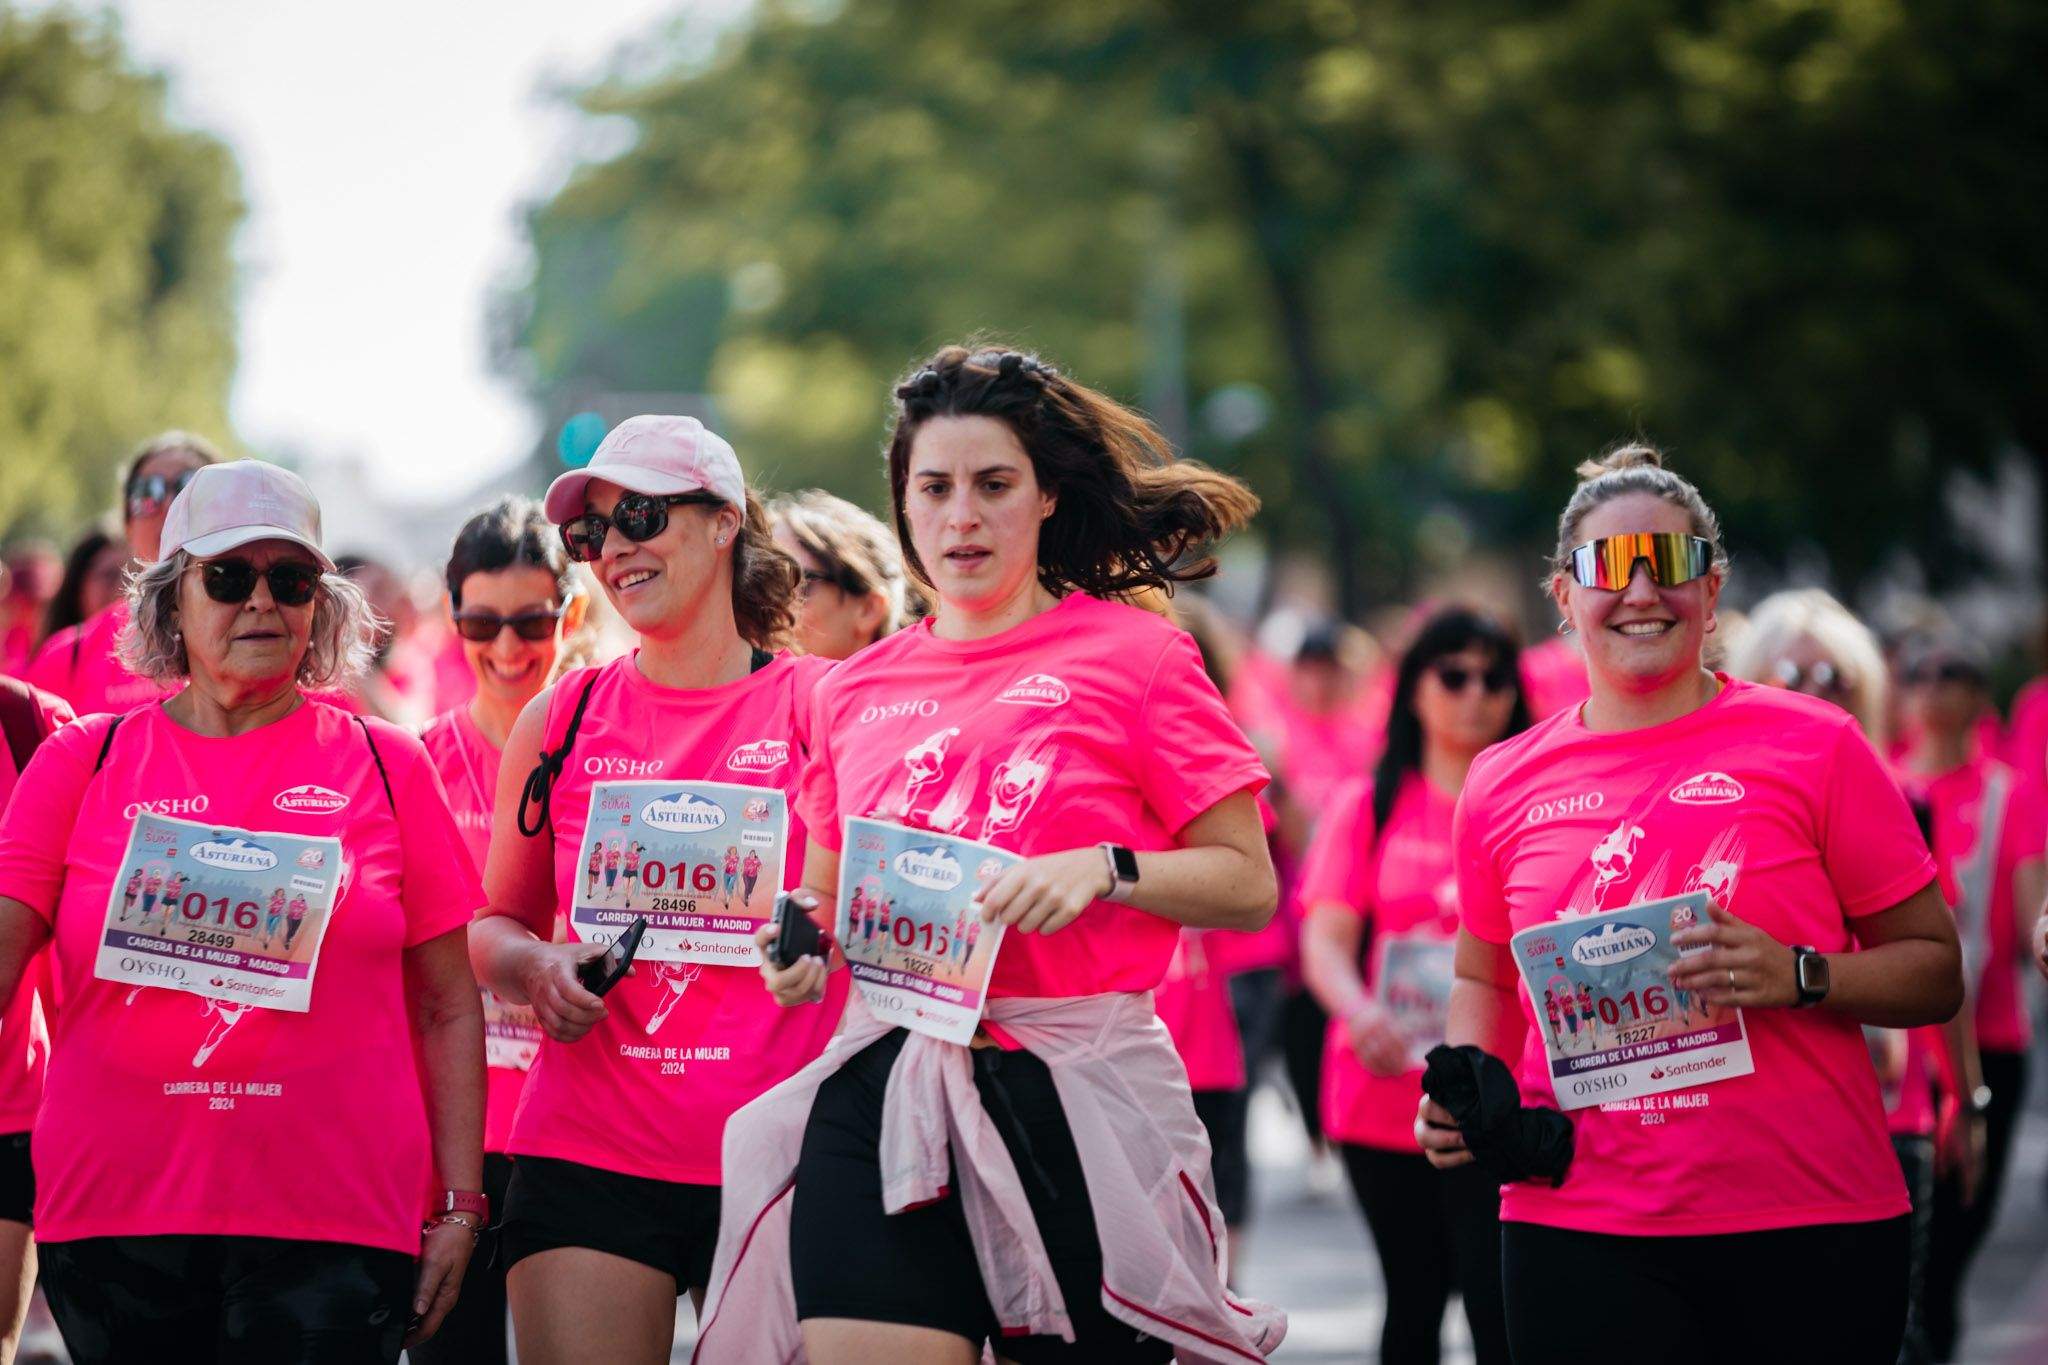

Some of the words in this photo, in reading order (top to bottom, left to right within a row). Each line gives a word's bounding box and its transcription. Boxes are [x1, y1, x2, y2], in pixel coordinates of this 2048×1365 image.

[860, 699, 939, 724] OYSHO
[583, 756, 664, 776] OYSHO
[280, 796, 344, 808] ASTURIANA
[1676, 787, 1739, 800] ASTURIANA
[123, 795, 209, 820] OYSHO
[601, 800, 631, 810] SUMA
[645, 805, 720, 825] ASTURIANA
[1527, 791, 1604, 825] OYSHO
[144, 832, 177, 844] SUMA
[194, 845, 271, 868] ASTURIANA
[642, 860, 717, 892] 016
[181, 892, 261, 930] 016
[651, 897, 696, 912] 28496
[1674, 906, 1693, 923] 20
[596, 911, 639, 923] CARRERA
[656, 915, 669, 926] LA
[671, 916, 704, 928] MUJER
[713, 918, 752, 931] MADRID
[187, 929, 235, 949] 28499
[693, 941, 753, 956] Santander
[1579, 935, 1652, 961] ASTURIANA
[126, 935, 172, 953] CARRERA
[175, 944, 189, 957] DE
[190, 947, 204, 959] LA
[206, 949, 241, 966] MUJER
[248, 958, 291, 974] MADRID
[1527, 942, 1557, 958] SUMA
[120, 957, 186, 981] OYSHO
[225, 978, 287, 998] Santander
[1599, 985, 1670, 1026] 016
[1615, 1026, 1656, 1046] 18227
[620, 1044, 661, 1059] CARRERA
[664, 1048, 678, 1060] DE
[680, 1047, 693, 1060] LA
[695, 1047, 730, 1060] MUJER
[1570, 1056, 1607, 1071] CARRERA
[1608, 1053, 1621, 1063] DE
[1622, 1050, 1635, 1060] LA
[1636, 1042, 1669, 1057] MUJER
[1677, 1031, 1718, 1049] MADRID
[661, 1062, 686, 1075] 2024
[1573, 1072, 1628, 1096] OYSHO
[1665, 1056, 1728, 1078] Santander
[163, 1081, 210, 1095] CARRERA
[213, 1082, 228, 1094] DE
[230, 1082, 243, 1095] LA
[245, 1083, 283, 1096] MUJER
[208, 1098, 235, 1110] 2024
[1643, 1097, 1656, 1110] DE
[1658, 1096, 1671, 1110] LA
[1672, 1092, 1709, 1109] MUJER
[1640, 1112, 1666, 1126] 2024
